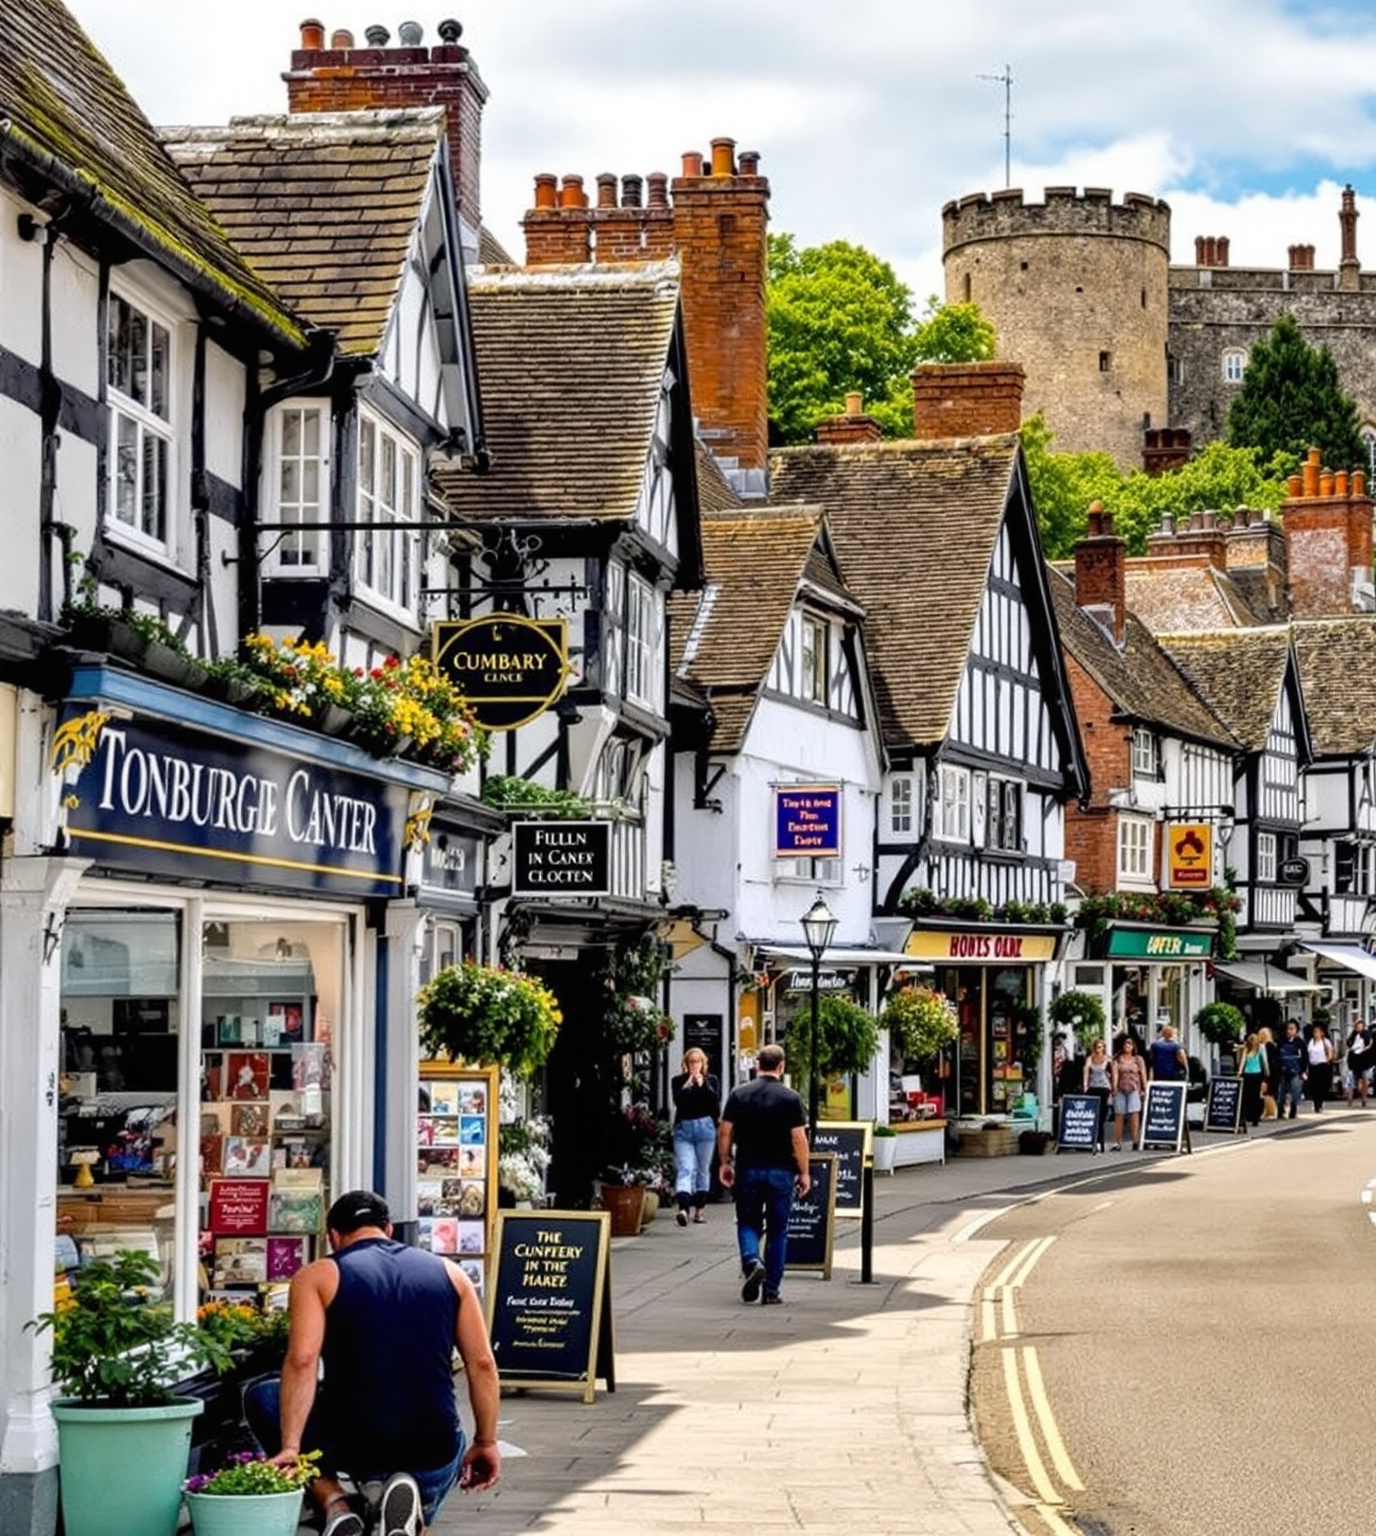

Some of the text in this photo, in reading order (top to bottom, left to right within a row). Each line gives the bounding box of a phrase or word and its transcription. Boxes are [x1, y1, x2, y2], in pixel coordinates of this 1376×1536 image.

[453, 652, 547, 670] CUMBARY
[286, 769, 377, 856] CANTER
[536, 1231, 562, 1244] THE
